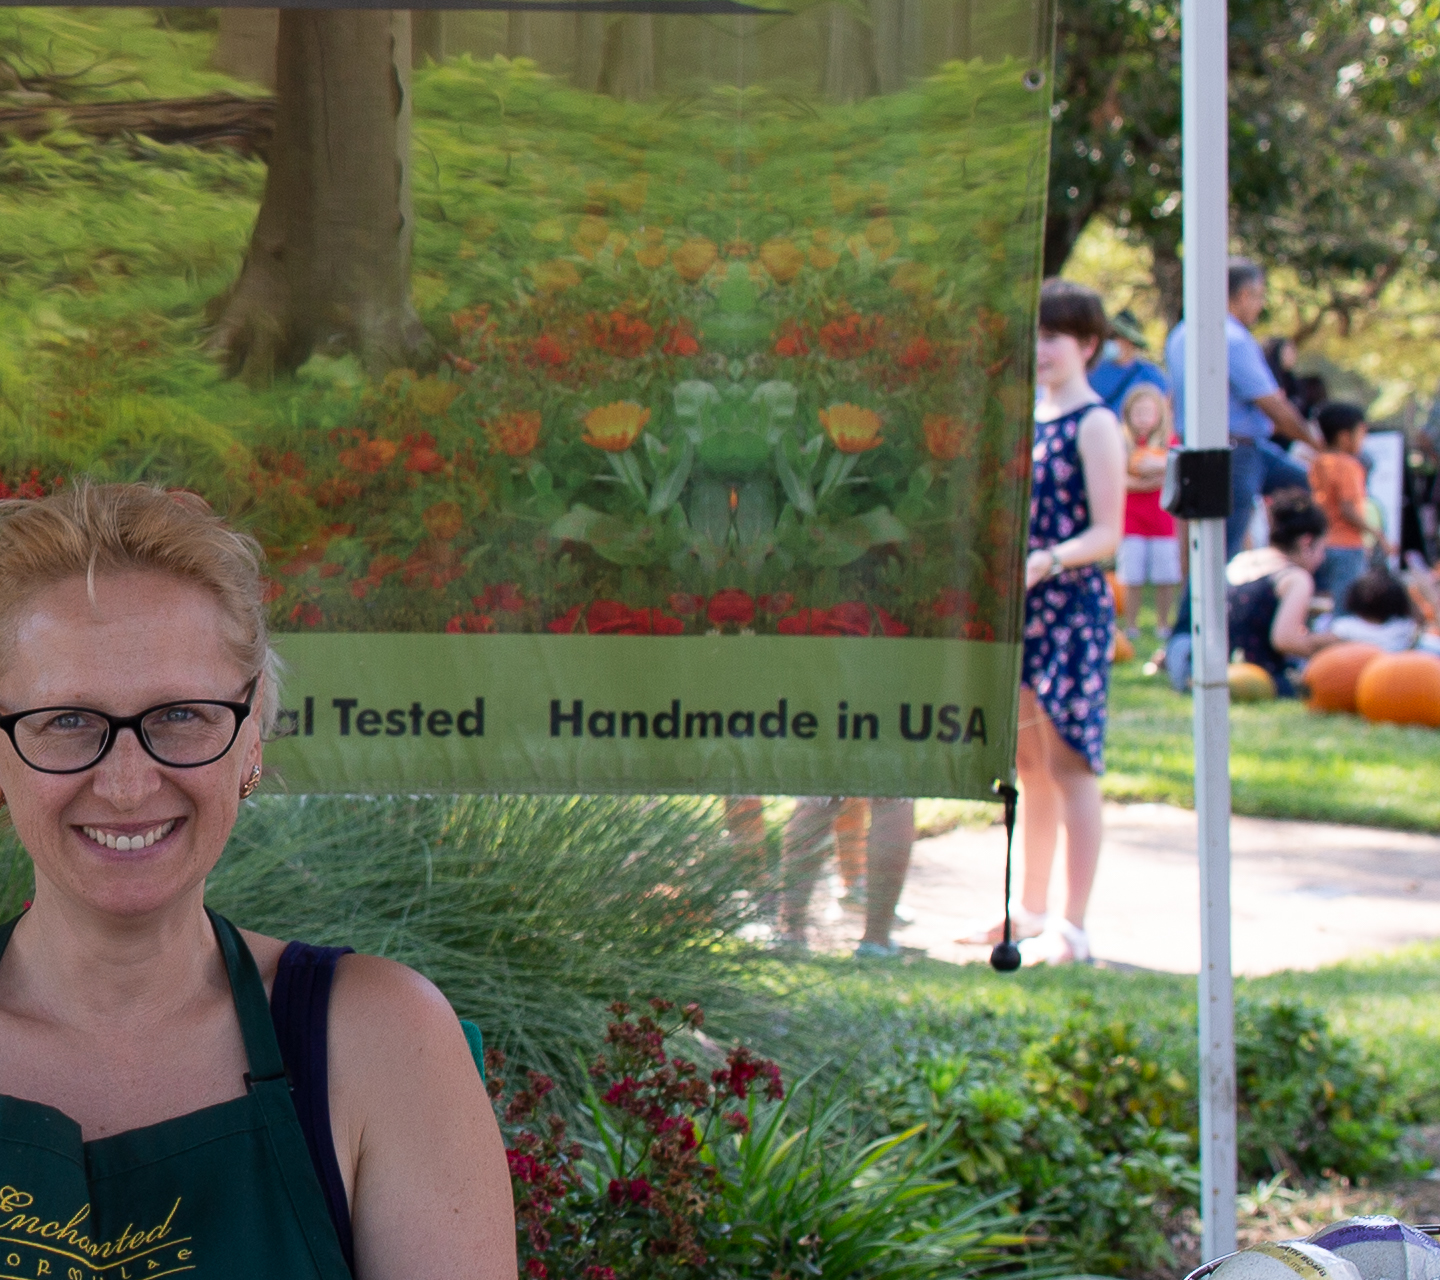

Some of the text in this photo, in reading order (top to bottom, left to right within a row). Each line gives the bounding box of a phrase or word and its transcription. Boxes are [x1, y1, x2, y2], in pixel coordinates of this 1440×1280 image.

[332, 697, 484, 741] Tested
[548, 699, 819, 742] Handmade
[837, 703, 879, 741] in
[898, 704, 987, 745] USA
